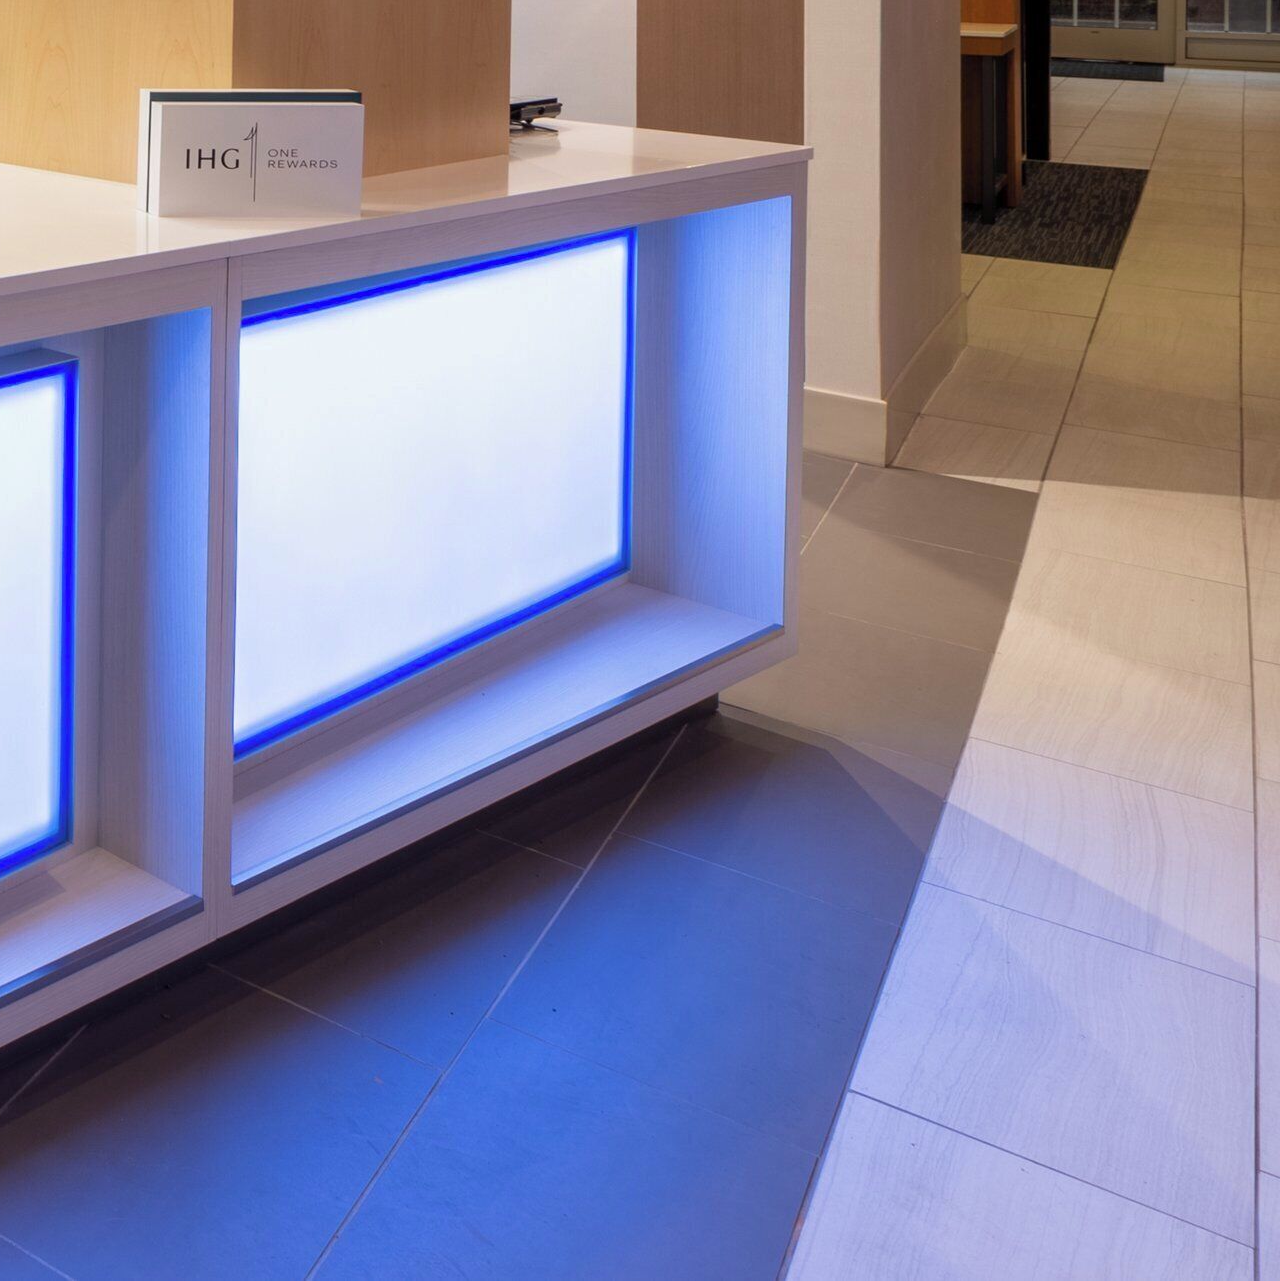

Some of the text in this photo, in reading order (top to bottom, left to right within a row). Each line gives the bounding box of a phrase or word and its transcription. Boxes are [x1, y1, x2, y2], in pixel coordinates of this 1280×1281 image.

[186, 148, 299, 170] IHG ONE
[267, 159, 338, 169] REWARDS
